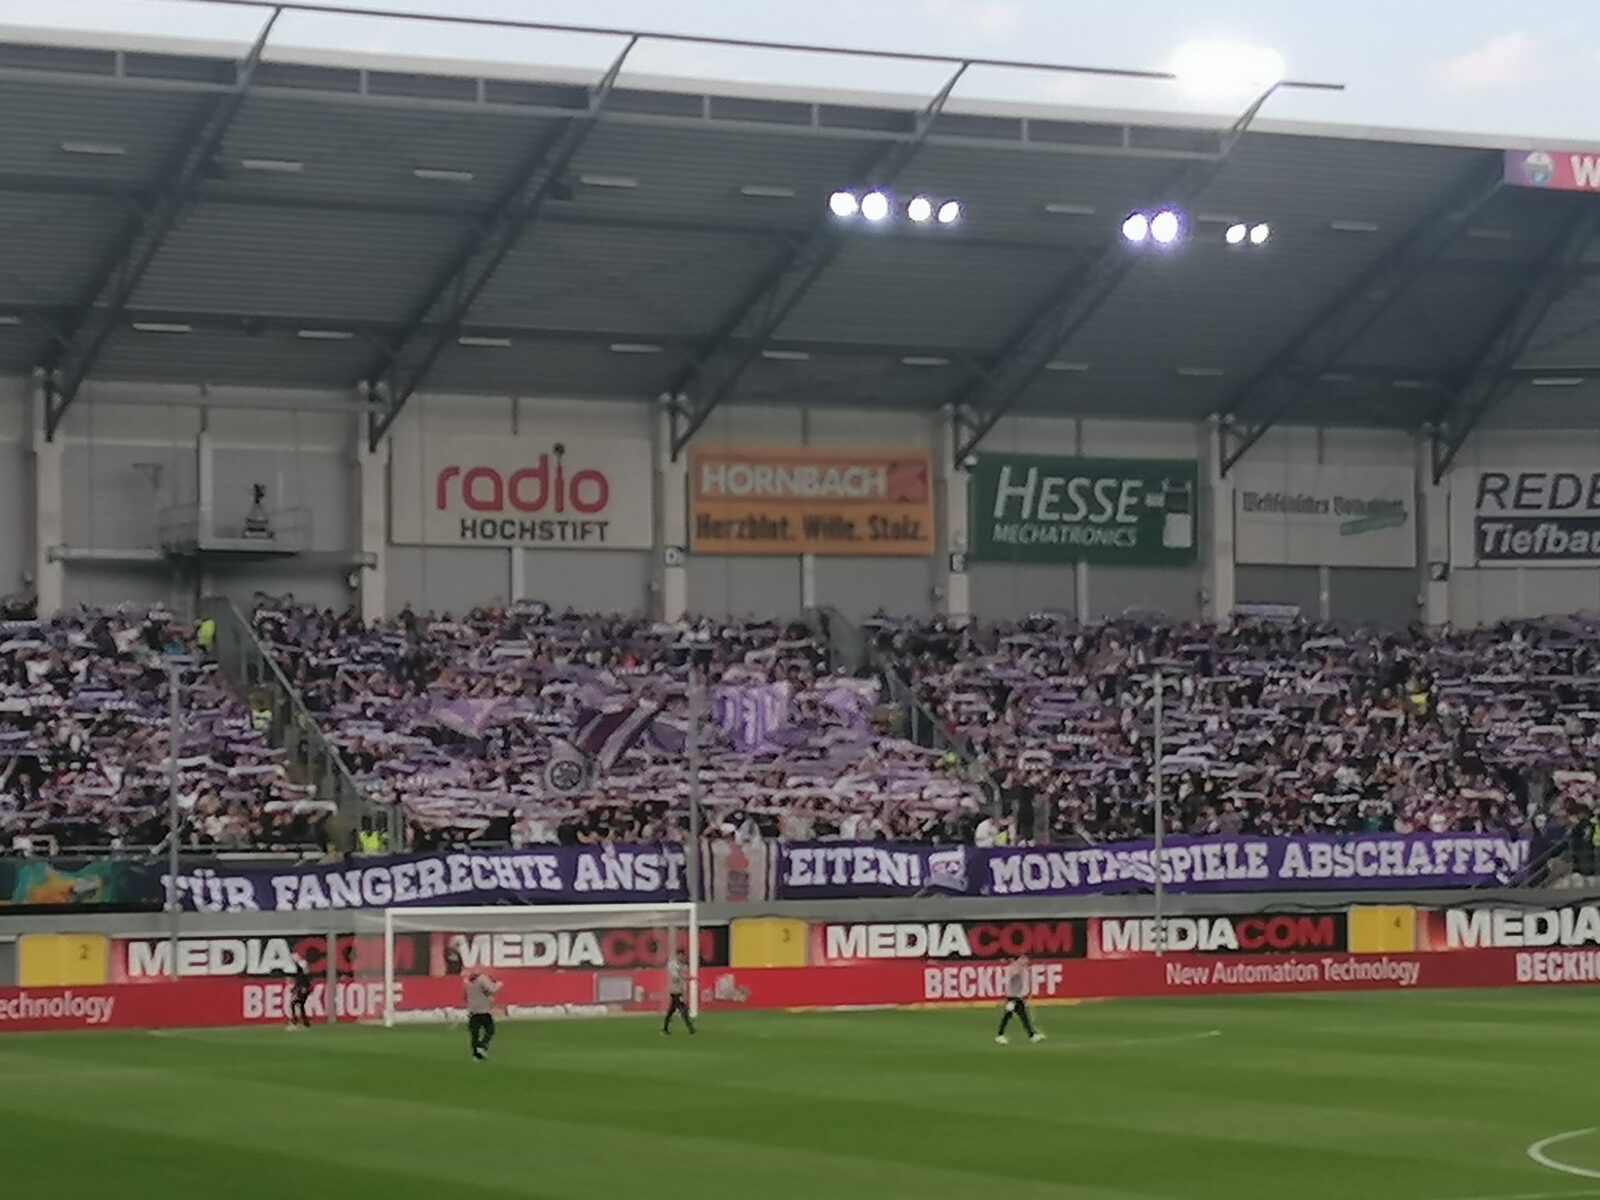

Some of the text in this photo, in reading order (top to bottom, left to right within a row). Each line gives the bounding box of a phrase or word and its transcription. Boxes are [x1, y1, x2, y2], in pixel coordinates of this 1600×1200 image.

[436, 443, 609, 514] radio
[701, 462, 887, 496] HORNBACH
[994, 466, 1143, 523] HESSE
[460, 518, 609, 541] HOCHSTIFT
[160, 868, 259, 912] FÜR
[271, 853, 563, 912] FANGERECHTE
[825, 922, 1073, 958] MEDIACOM
[1102, 916, 1335, 952] MEDIACOM
[924, 964, 1063, 999] BECKHFF
[1166, 957, 1420, 985] New Automation Technology
